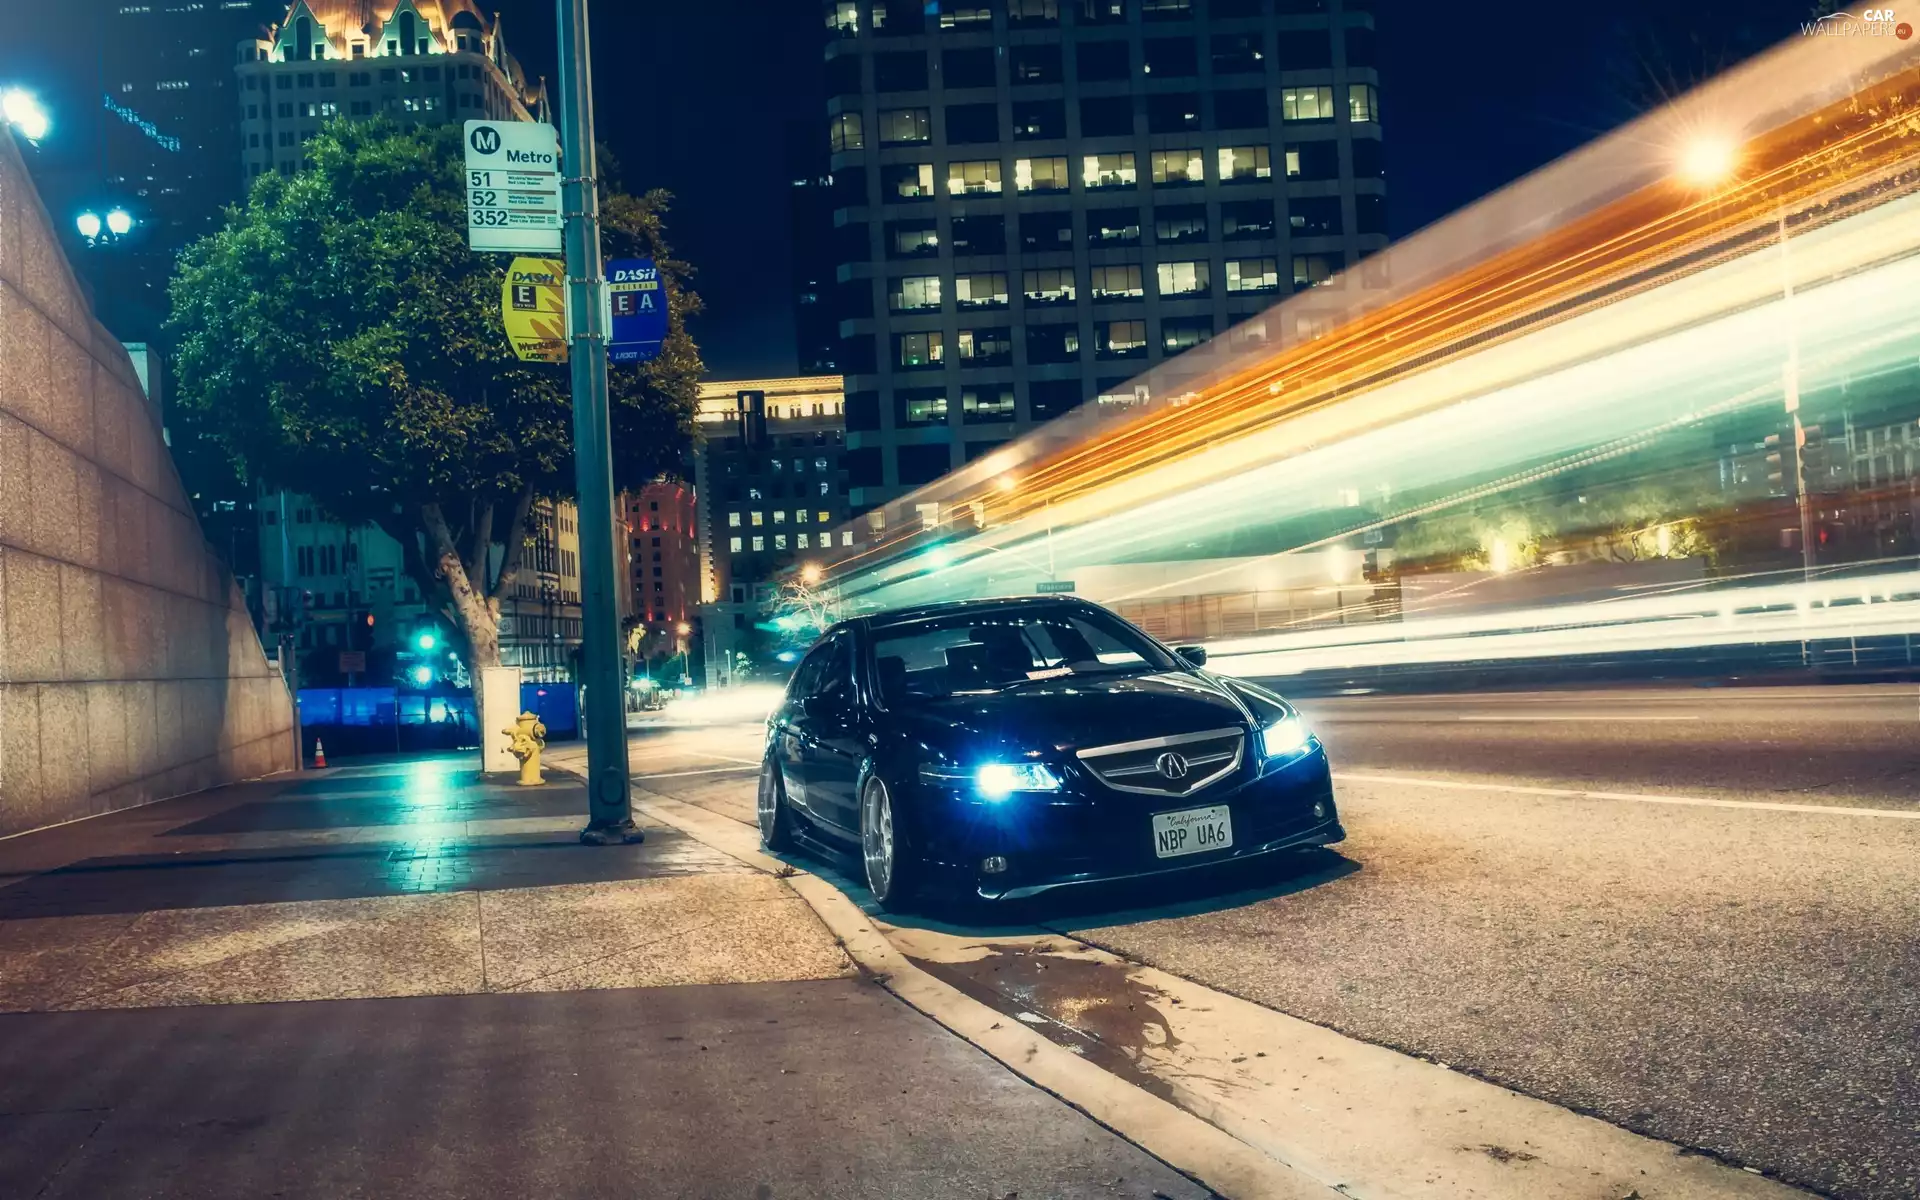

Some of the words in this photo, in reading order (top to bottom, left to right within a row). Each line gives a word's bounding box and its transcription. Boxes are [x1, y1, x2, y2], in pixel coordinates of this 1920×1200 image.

[475, 131, 496, 150] M
[506, 150, 552, 163] Metro
[471, 172, 490, 187] 51
[472, 191, 497, 207] 52
[472, 210, 509, 226] 352
[512, 271, 556, 285] DASH
[615, 268, 657, 282] DASH
[518, 286, 530, 303] E
[618, 295, 629, 311] E
[640, 293, 654, 309] A
[1170, 813, 1214, 827] California
[1158, 828, 1187, 852] NBP
[1196, 821, 1225, 845] UA6
